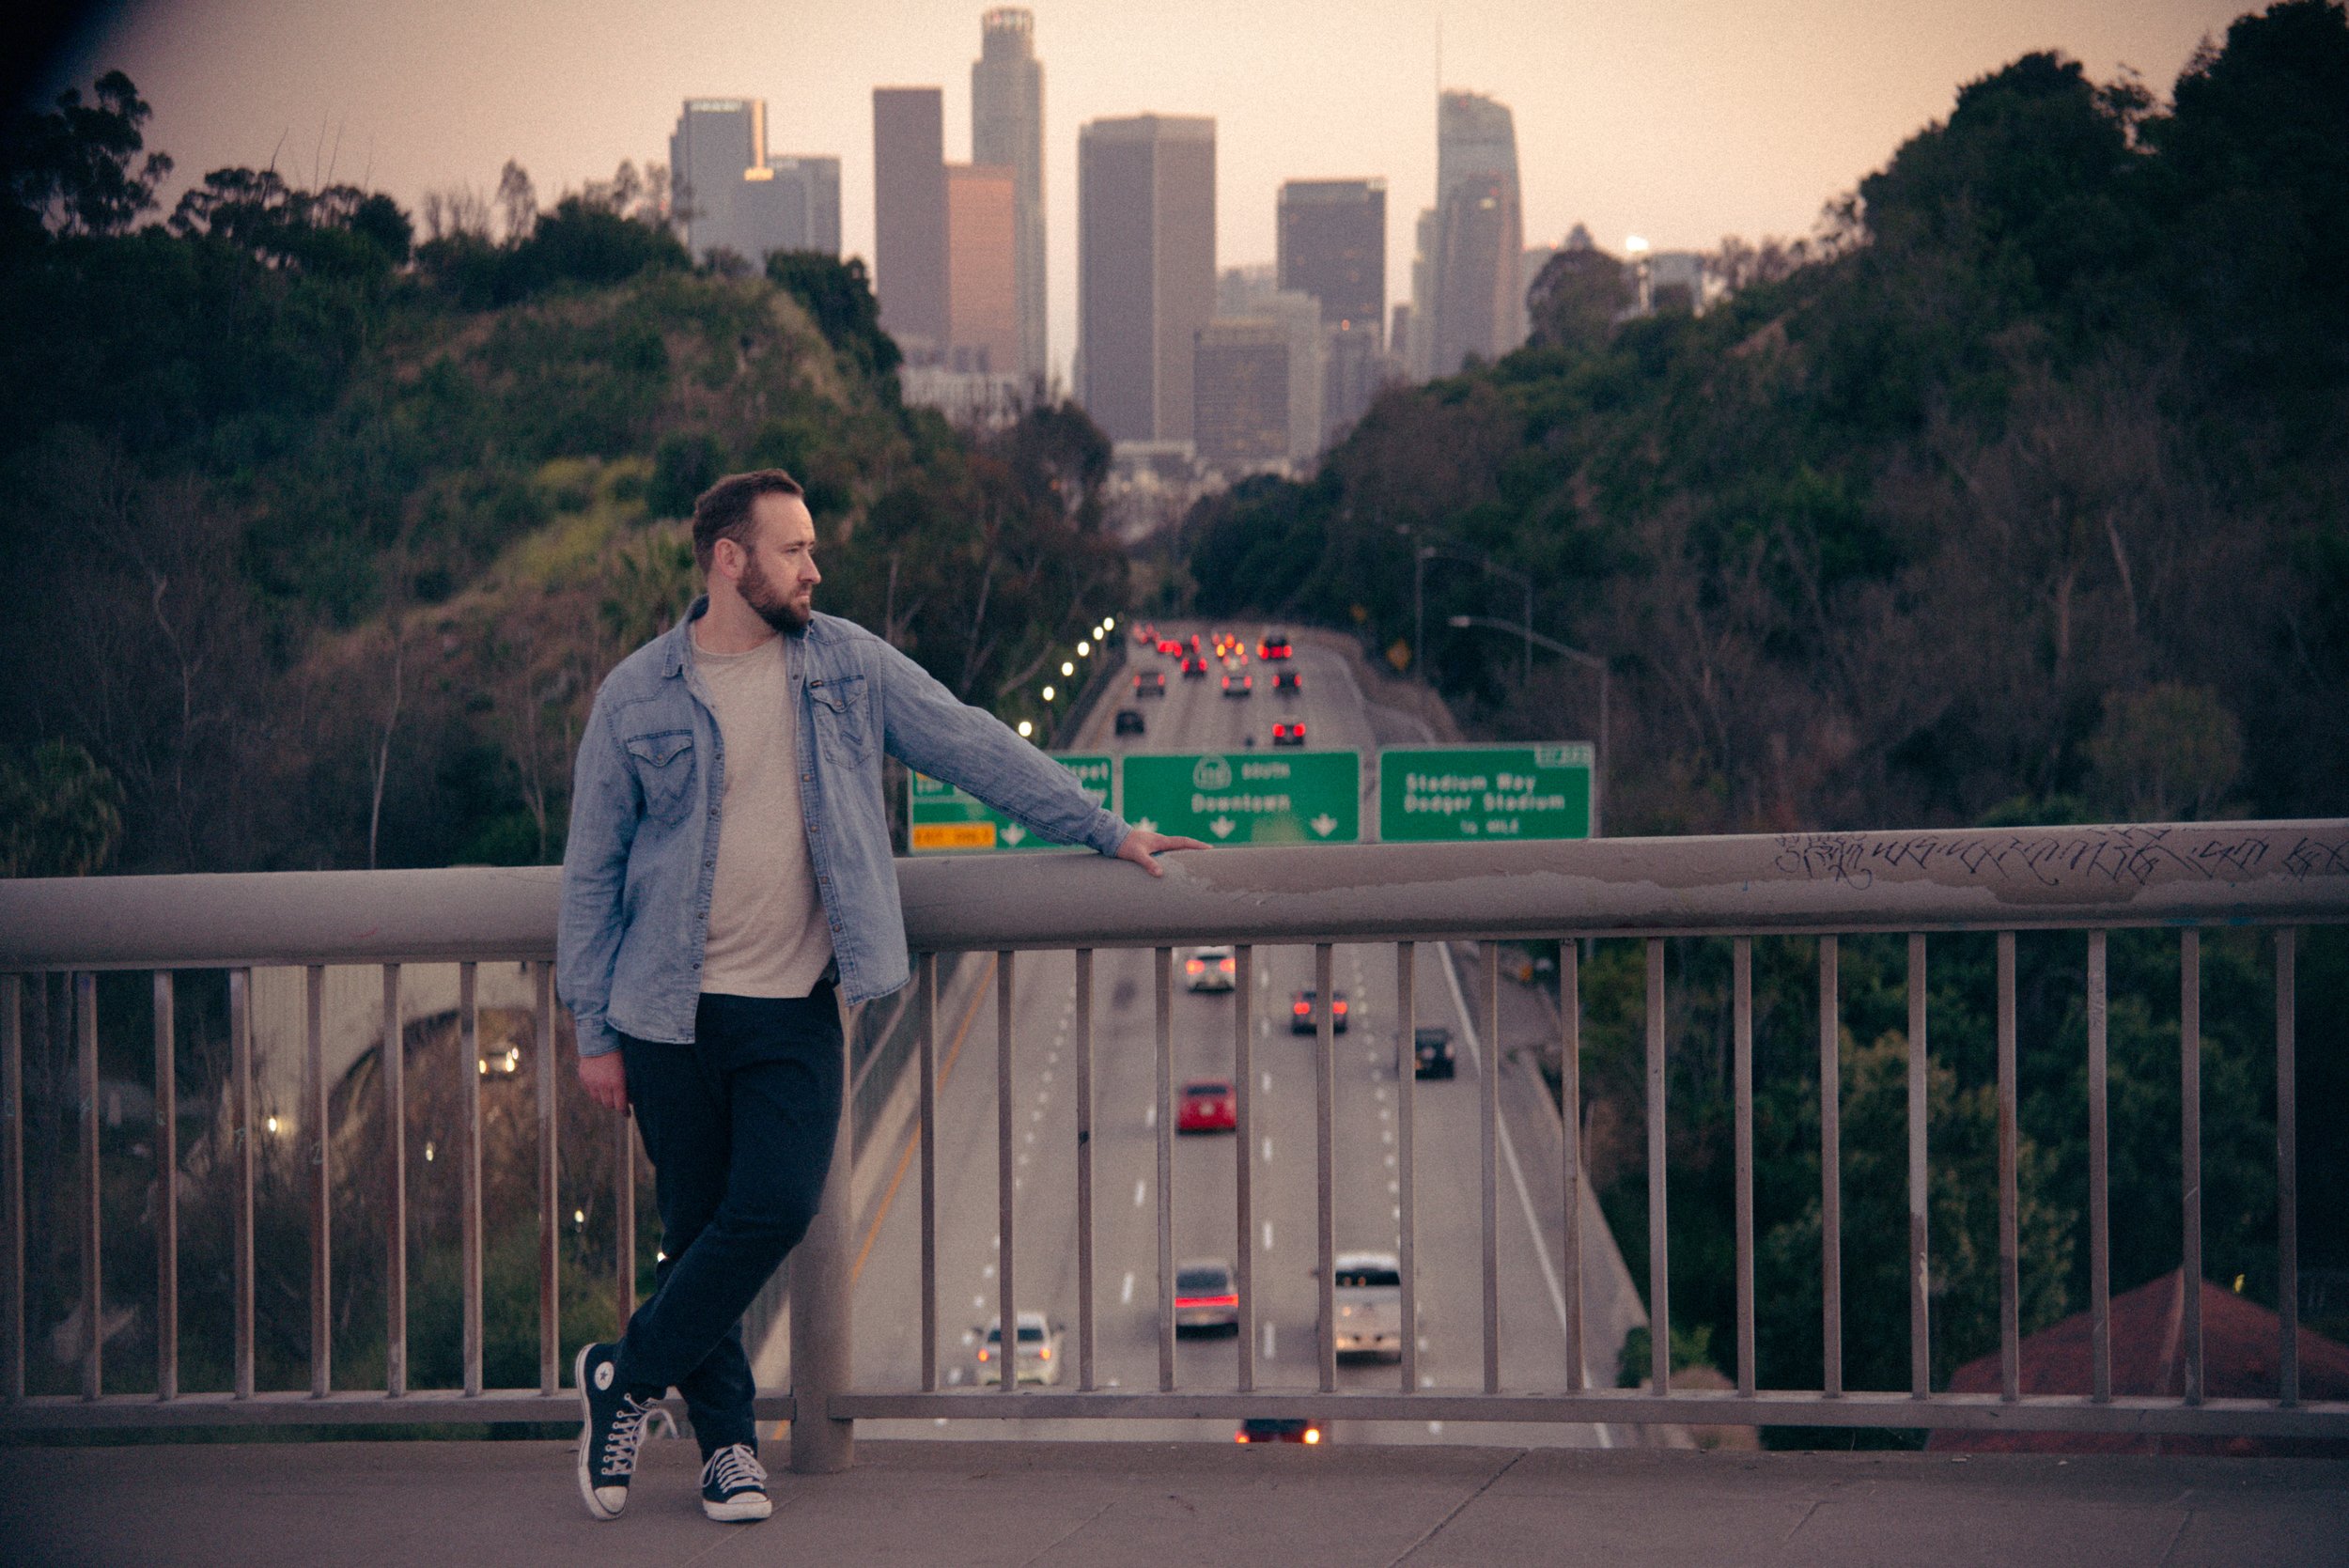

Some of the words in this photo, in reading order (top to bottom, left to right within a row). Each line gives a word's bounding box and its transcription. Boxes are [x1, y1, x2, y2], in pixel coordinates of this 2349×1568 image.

[1407, 773, 1487, 793] Stadium
[1497, 773, 1536, 797] Way
[1191, 793, 1290, 814] Downtown
[1405, 794, 1471, 815] Dodger
[1484, 793, 1564, 813] Stadium
